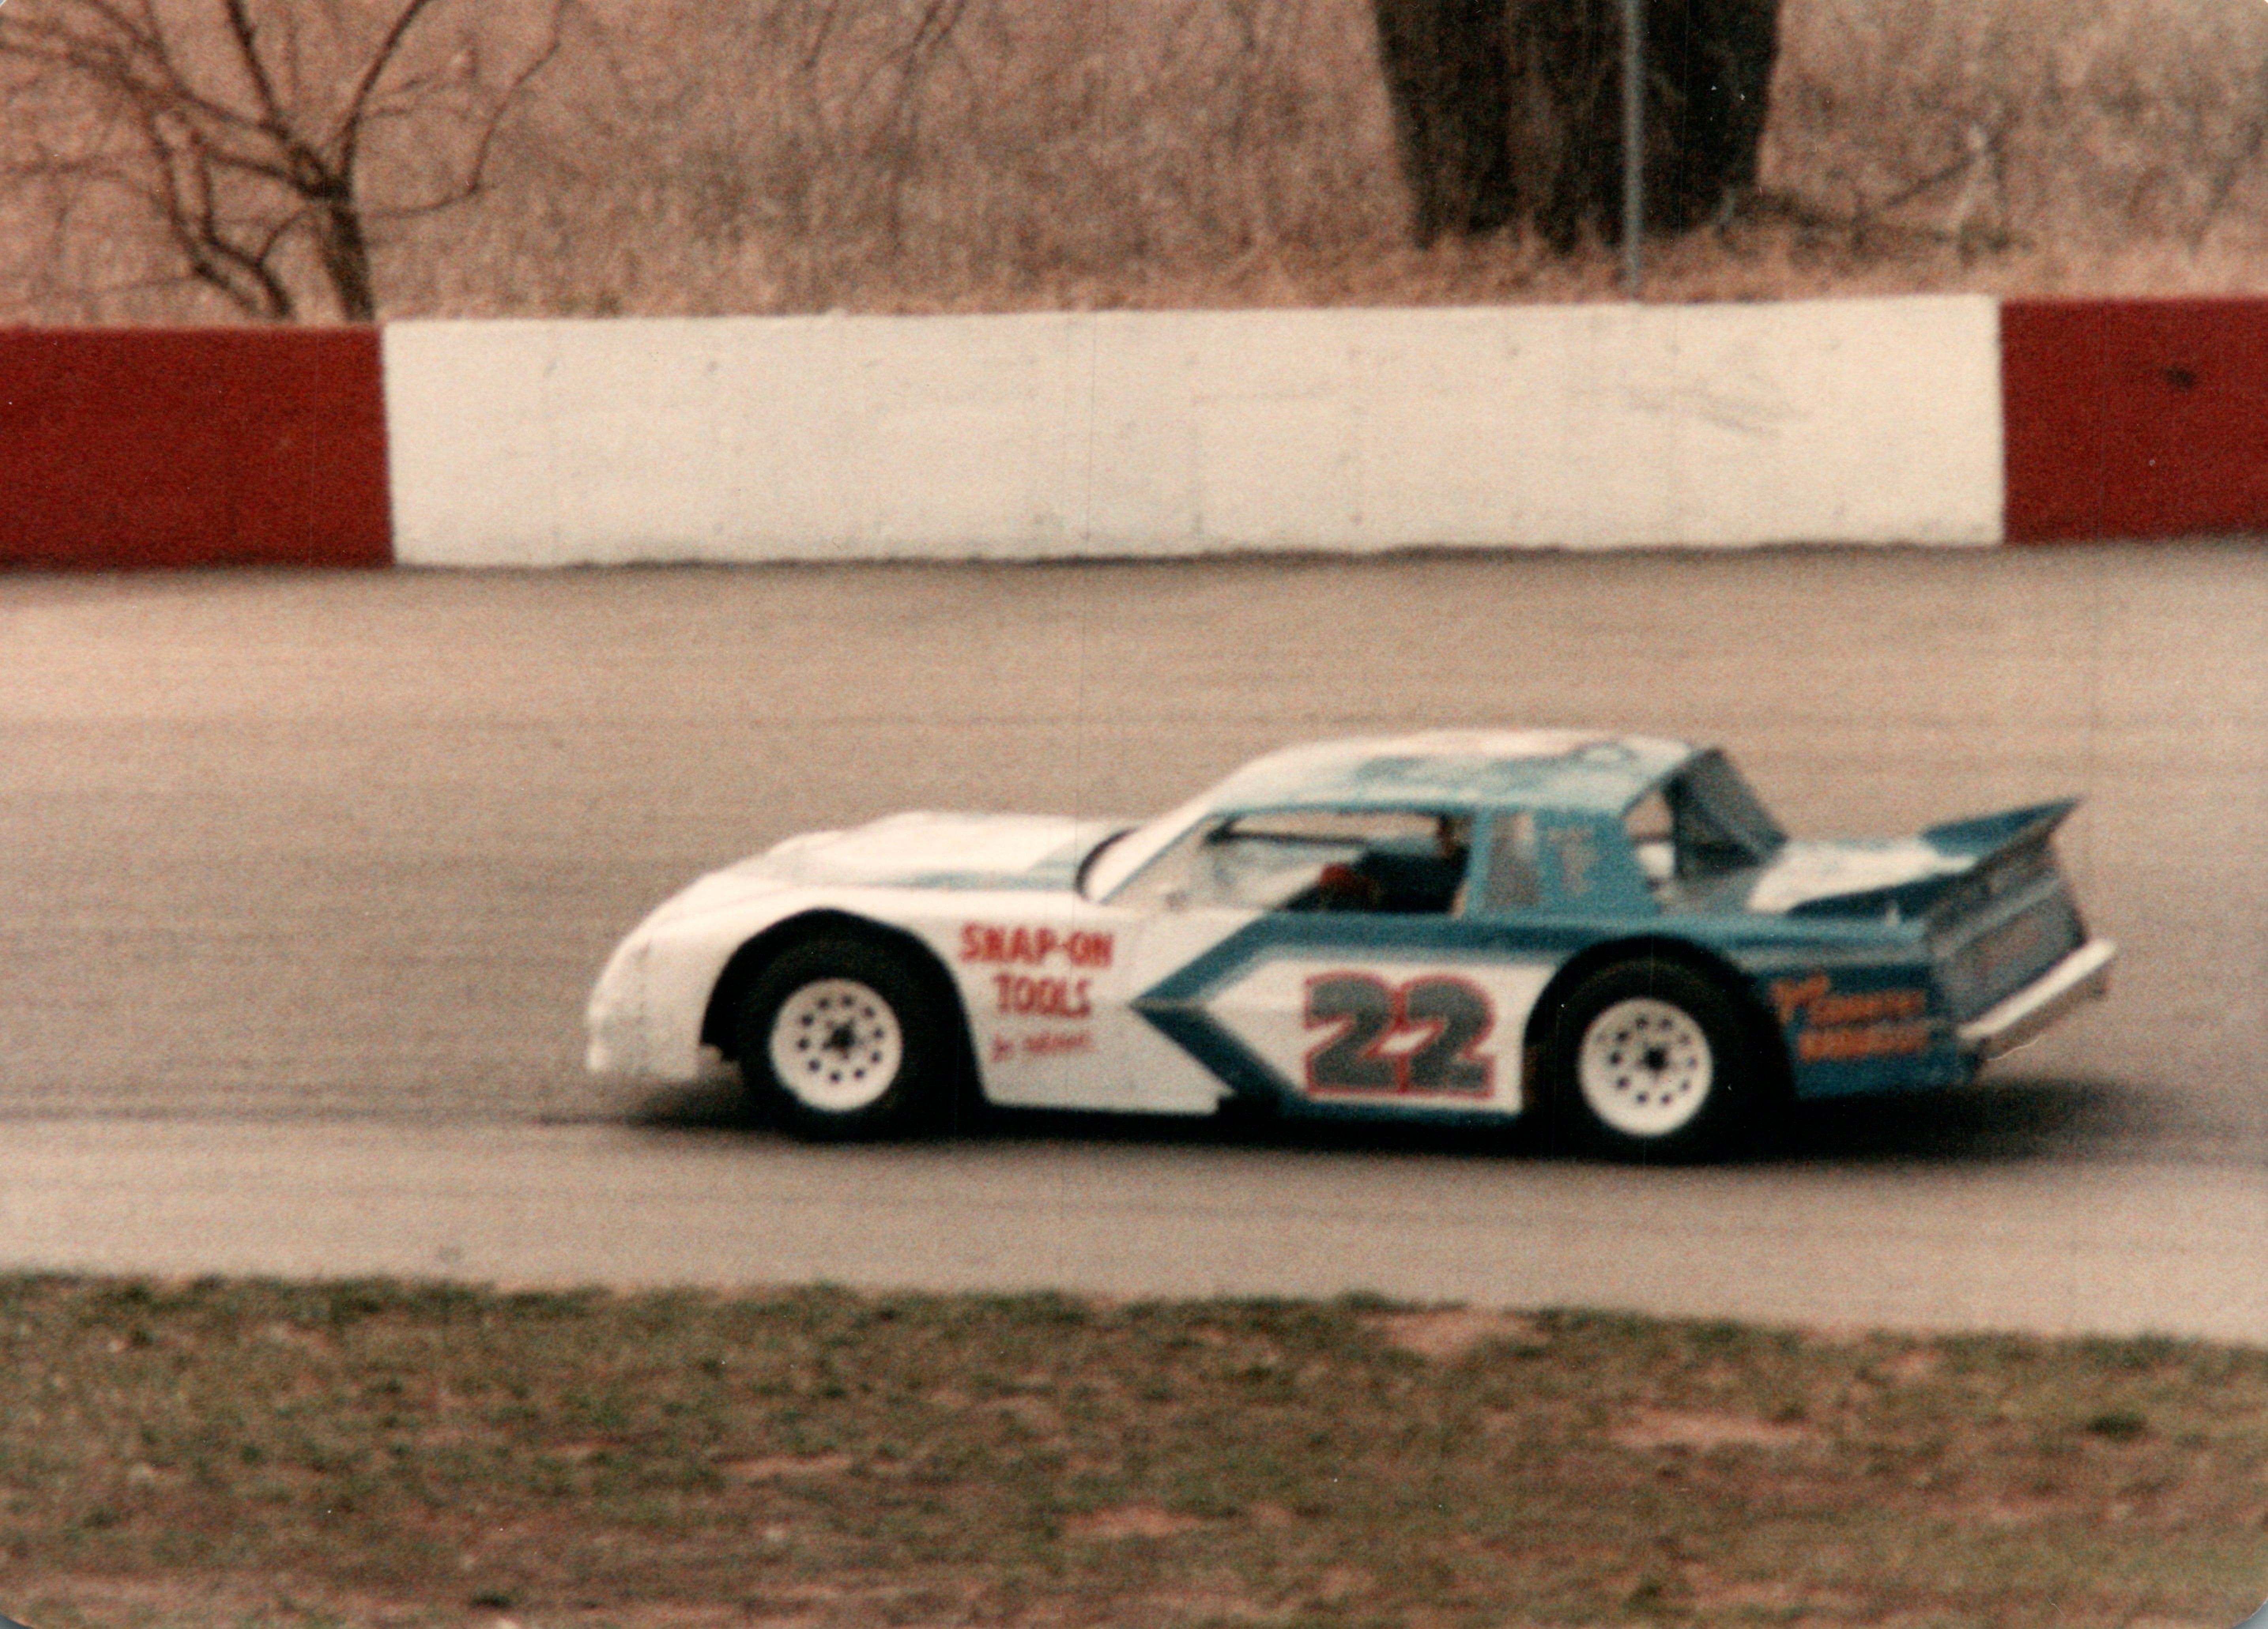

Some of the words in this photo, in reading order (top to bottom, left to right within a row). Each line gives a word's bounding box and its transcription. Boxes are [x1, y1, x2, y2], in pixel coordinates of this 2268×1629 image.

[959, 921, 1114, 969] SNAP-ON
[993, 973, 1092, 1018] TOOLS
[1303, 970, 1496, 1099] 22
